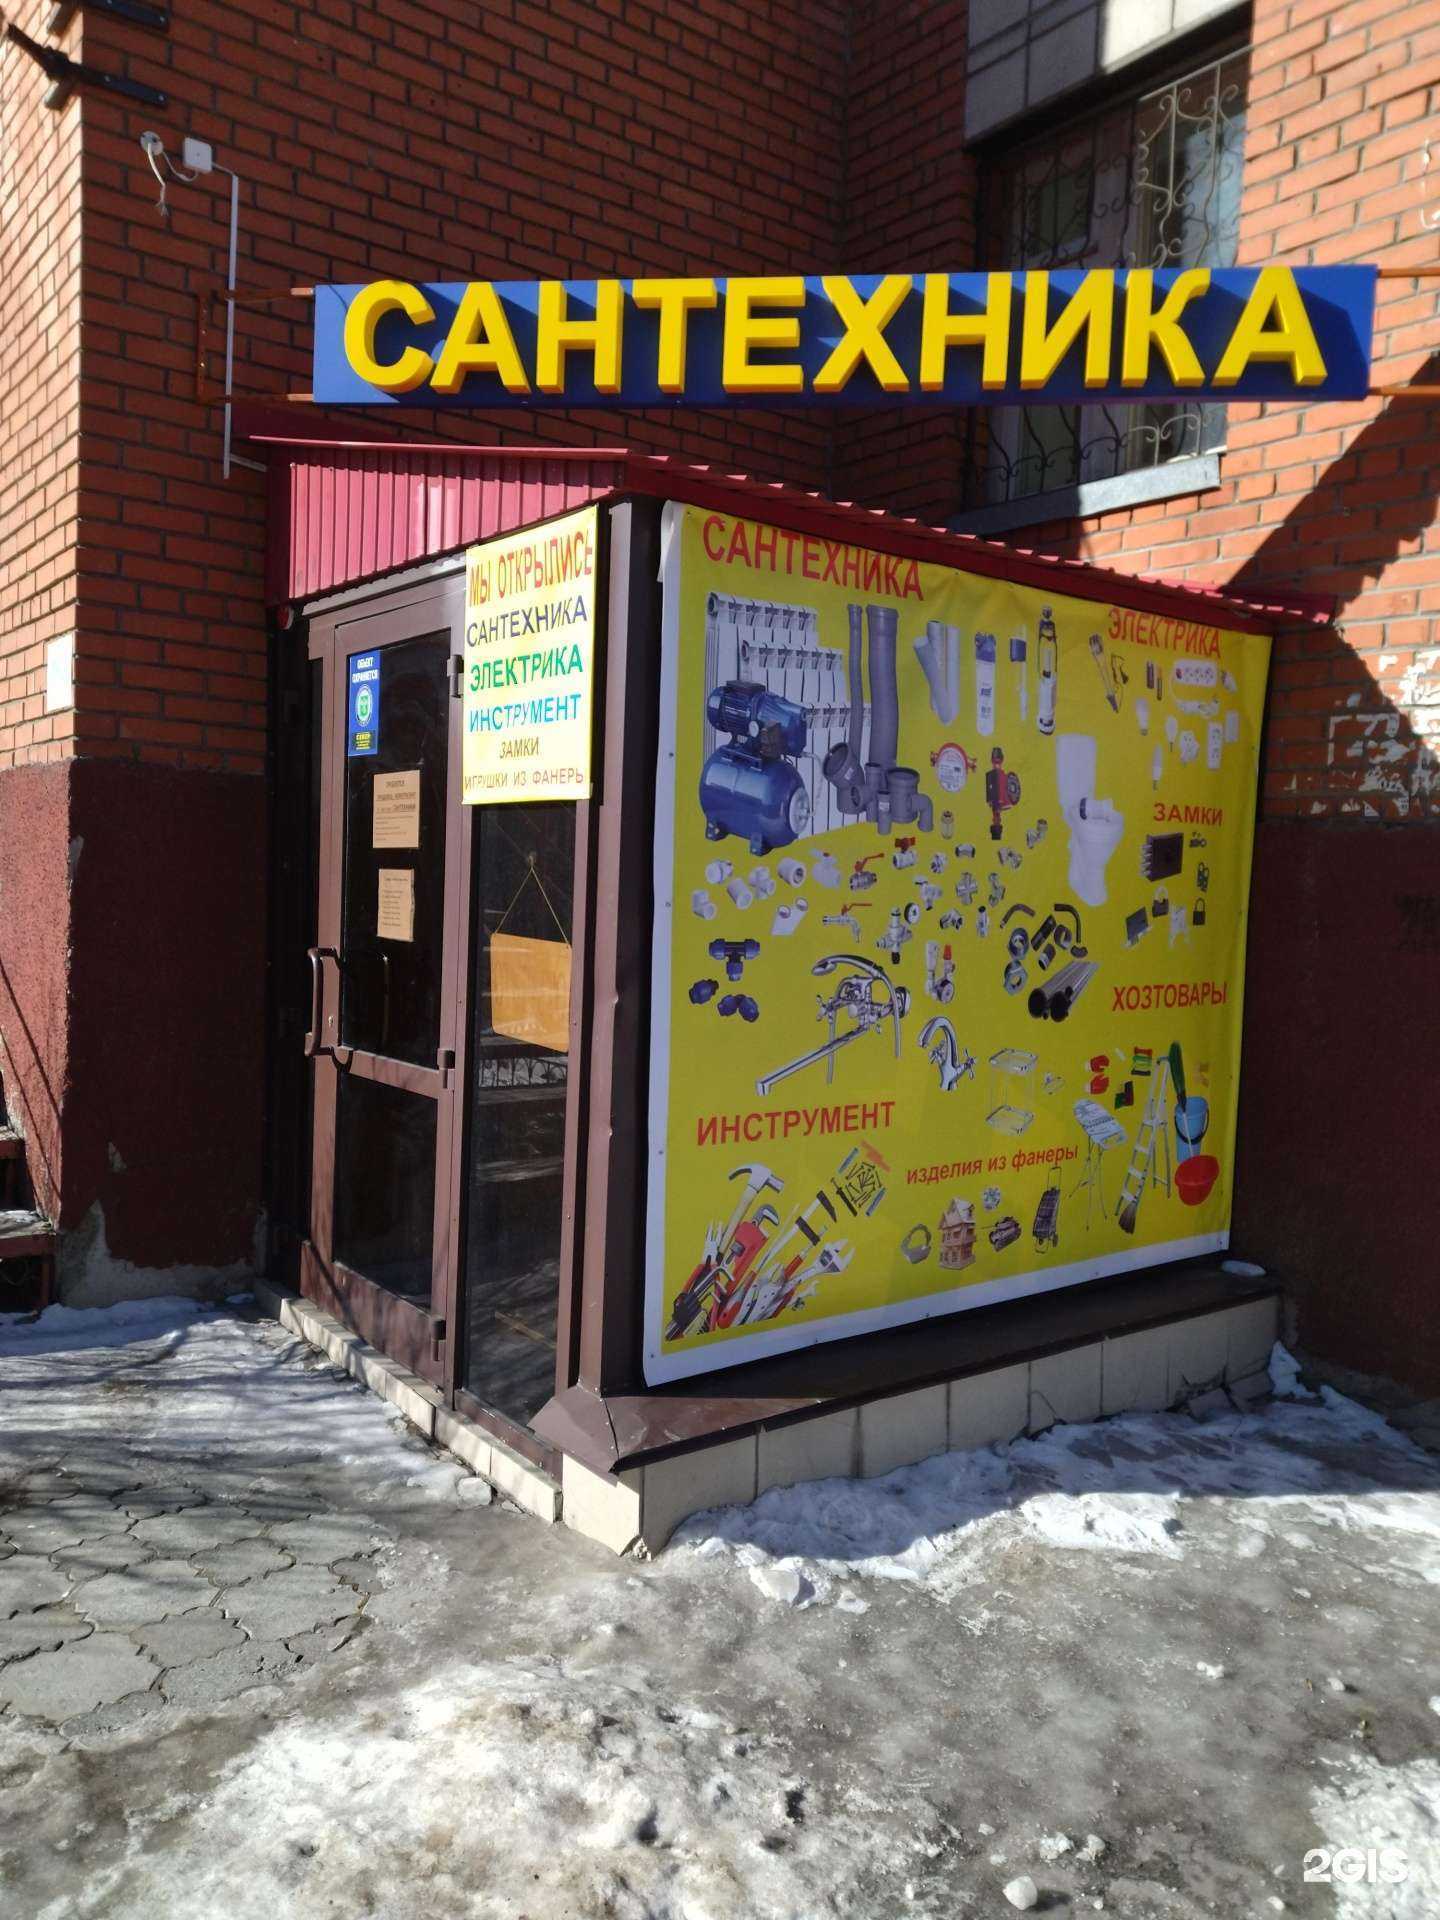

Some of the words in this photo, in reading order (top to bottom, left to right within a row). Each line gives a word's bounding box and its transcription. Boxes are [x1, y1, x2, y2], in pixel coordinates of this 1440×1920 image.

[343, 266, 1328, 394] САНТЕХНИКА
[469, 559, 491, 608] МЫ
[498, 528, 593, 599] ОТКРЫЛИСЬ
[702, 514, 924, 601] САНТЕХНИКА
[466, 595, 588, 648] САНТЕХНИКА
[1107, 607, 1221, 658] ЭЛЕКТРИКА
[470, 643, 583, 692] ЭЛЕКТРИКА
[470, 693, 582, 733] ИНСТРУМЕНТ
[499, 736, 540, 759] ЗАМКИ
[464, 772, 508, 791] ИГРУШКИ
[513, 770, 527, 786] ИЗ
[1153, 801, 1223, 827] ЗАМКИ
[1111, 982, 1227, 1012] ХОЗТОВАРЫ
[697, 1100, 896, 1147] ИНСТРУМЕНТ
[906, 1154, 982, 1185] изделия
[987, 1152, 1007, 1172] из
[1011, 1145, 1079, 1174] фанеры
